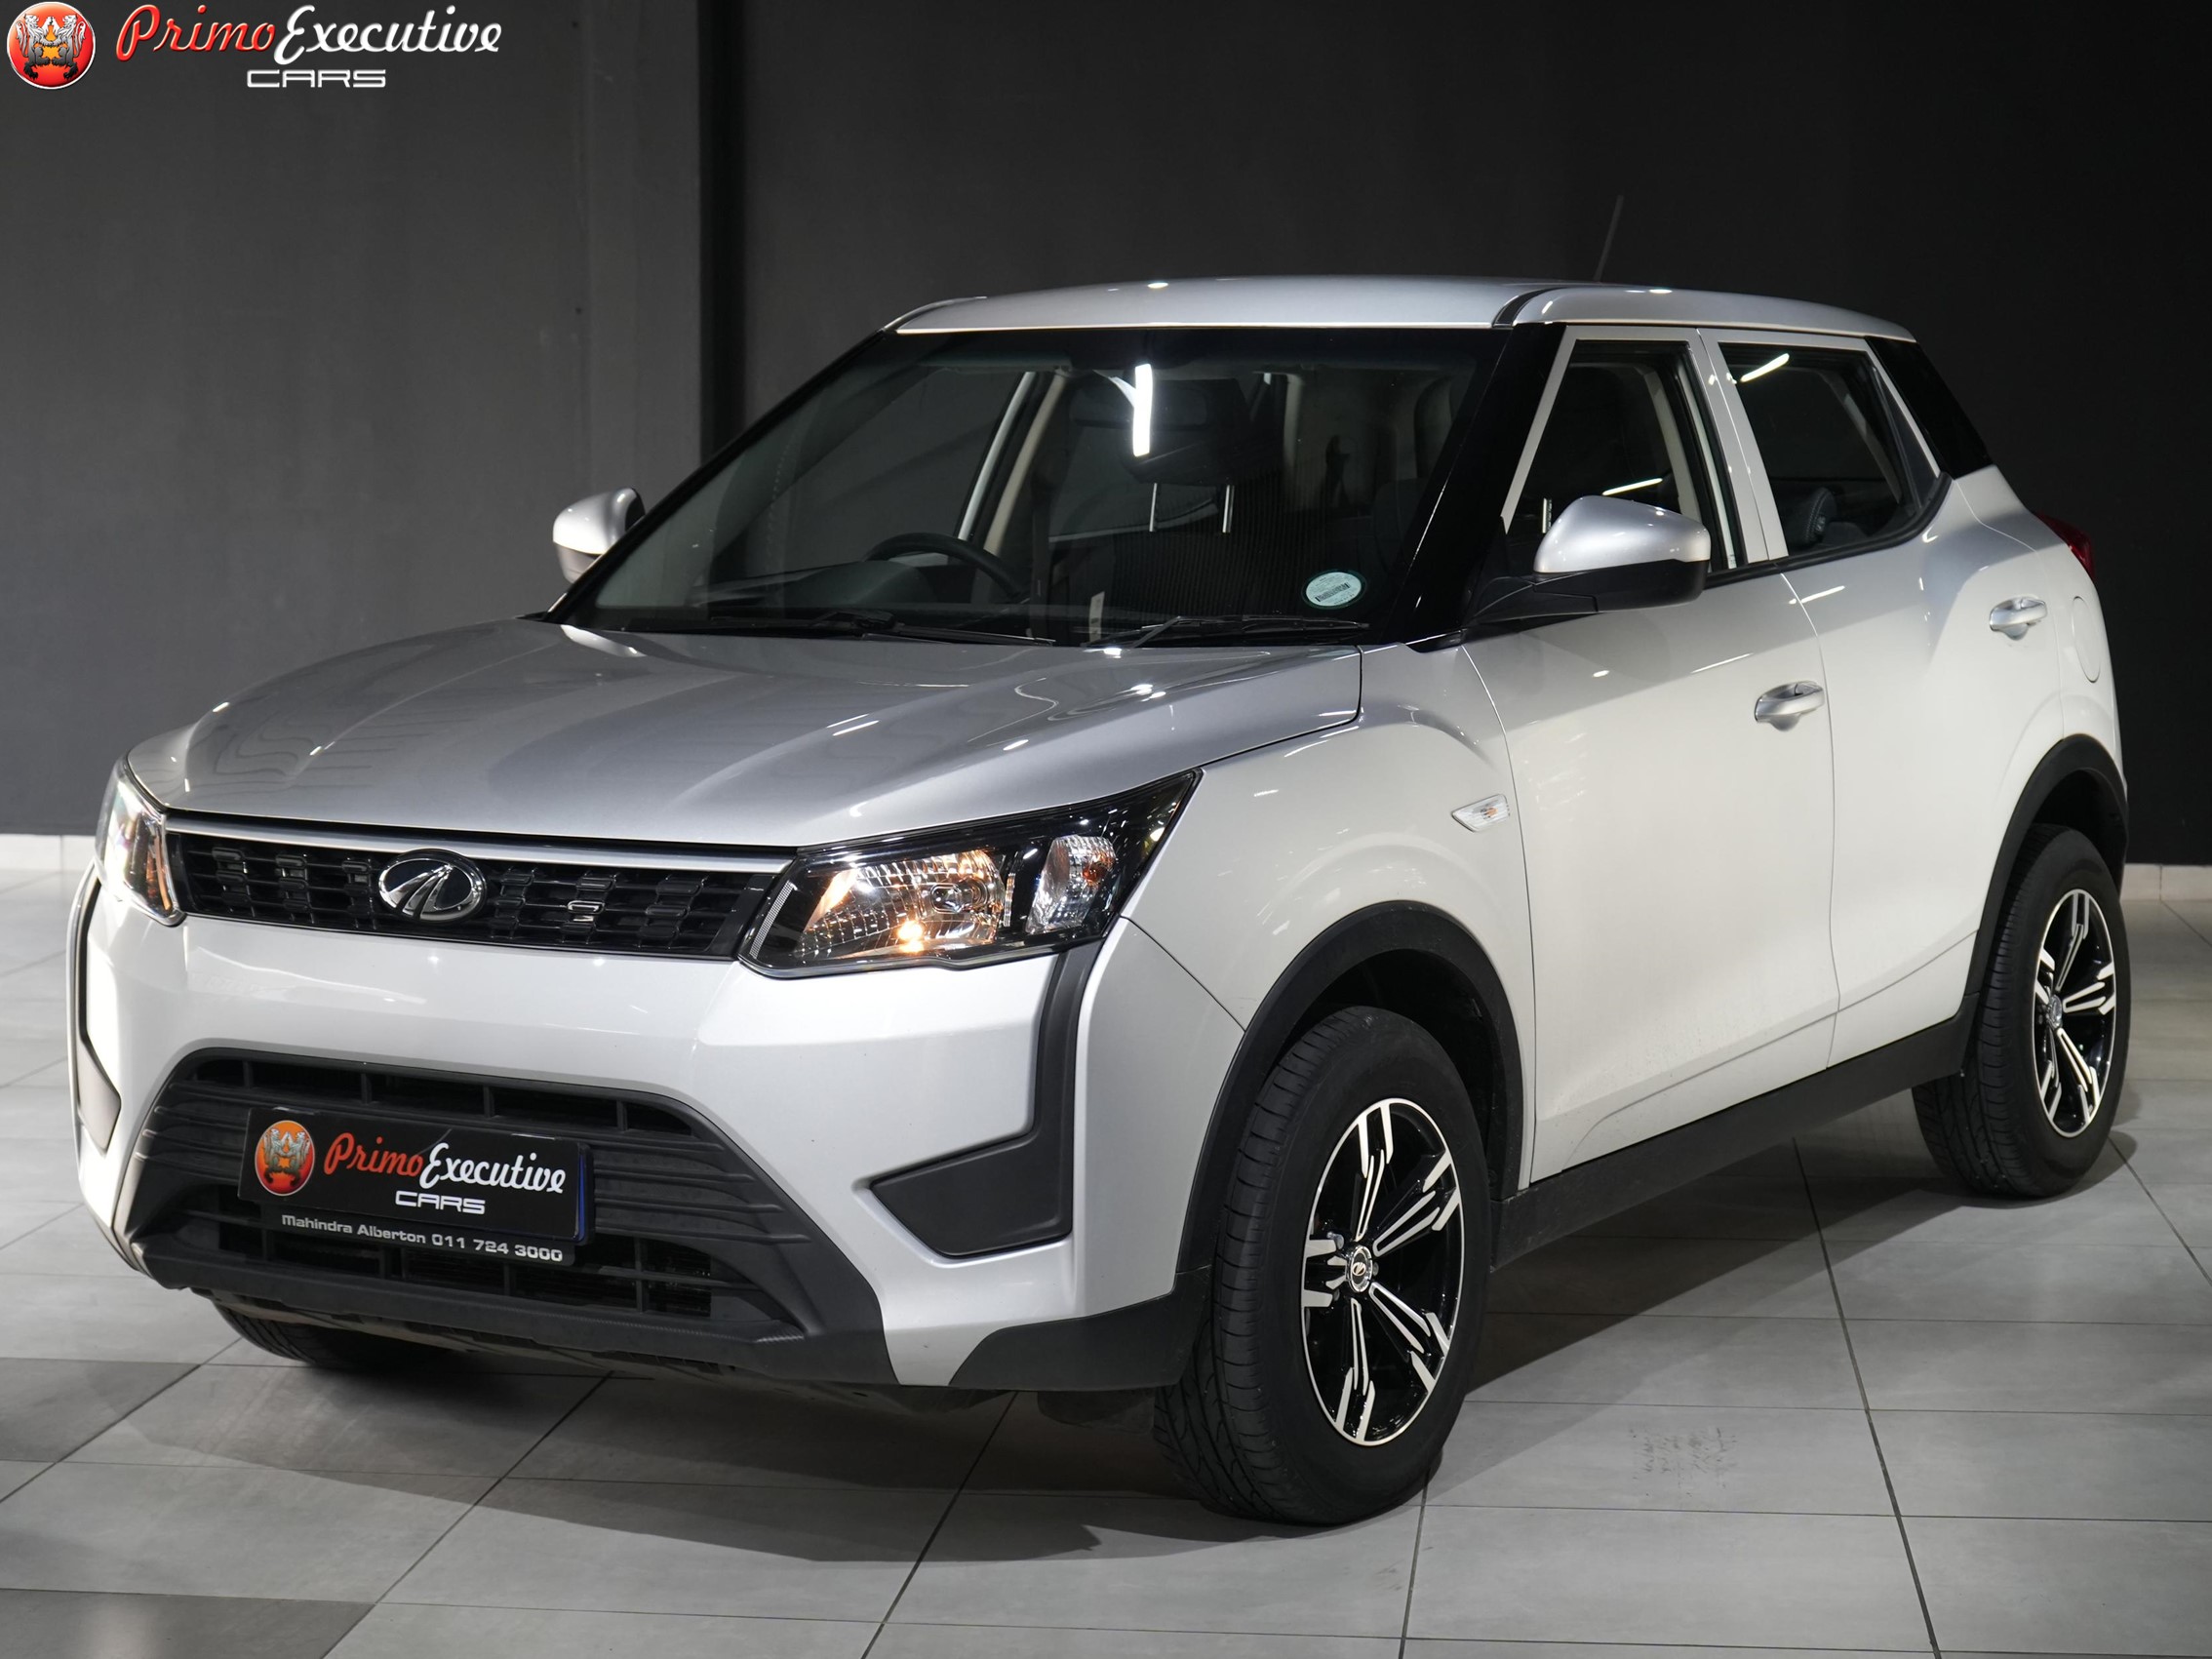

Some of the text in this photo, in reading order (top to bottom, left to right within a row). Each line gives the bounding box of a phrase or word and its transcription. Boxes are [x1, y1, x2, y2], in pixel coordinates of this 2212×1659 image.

[395, 1191, 486, 1215] CARS
[281, 1214, 563, 1262] Mahindra Alberton 011 724 3000
